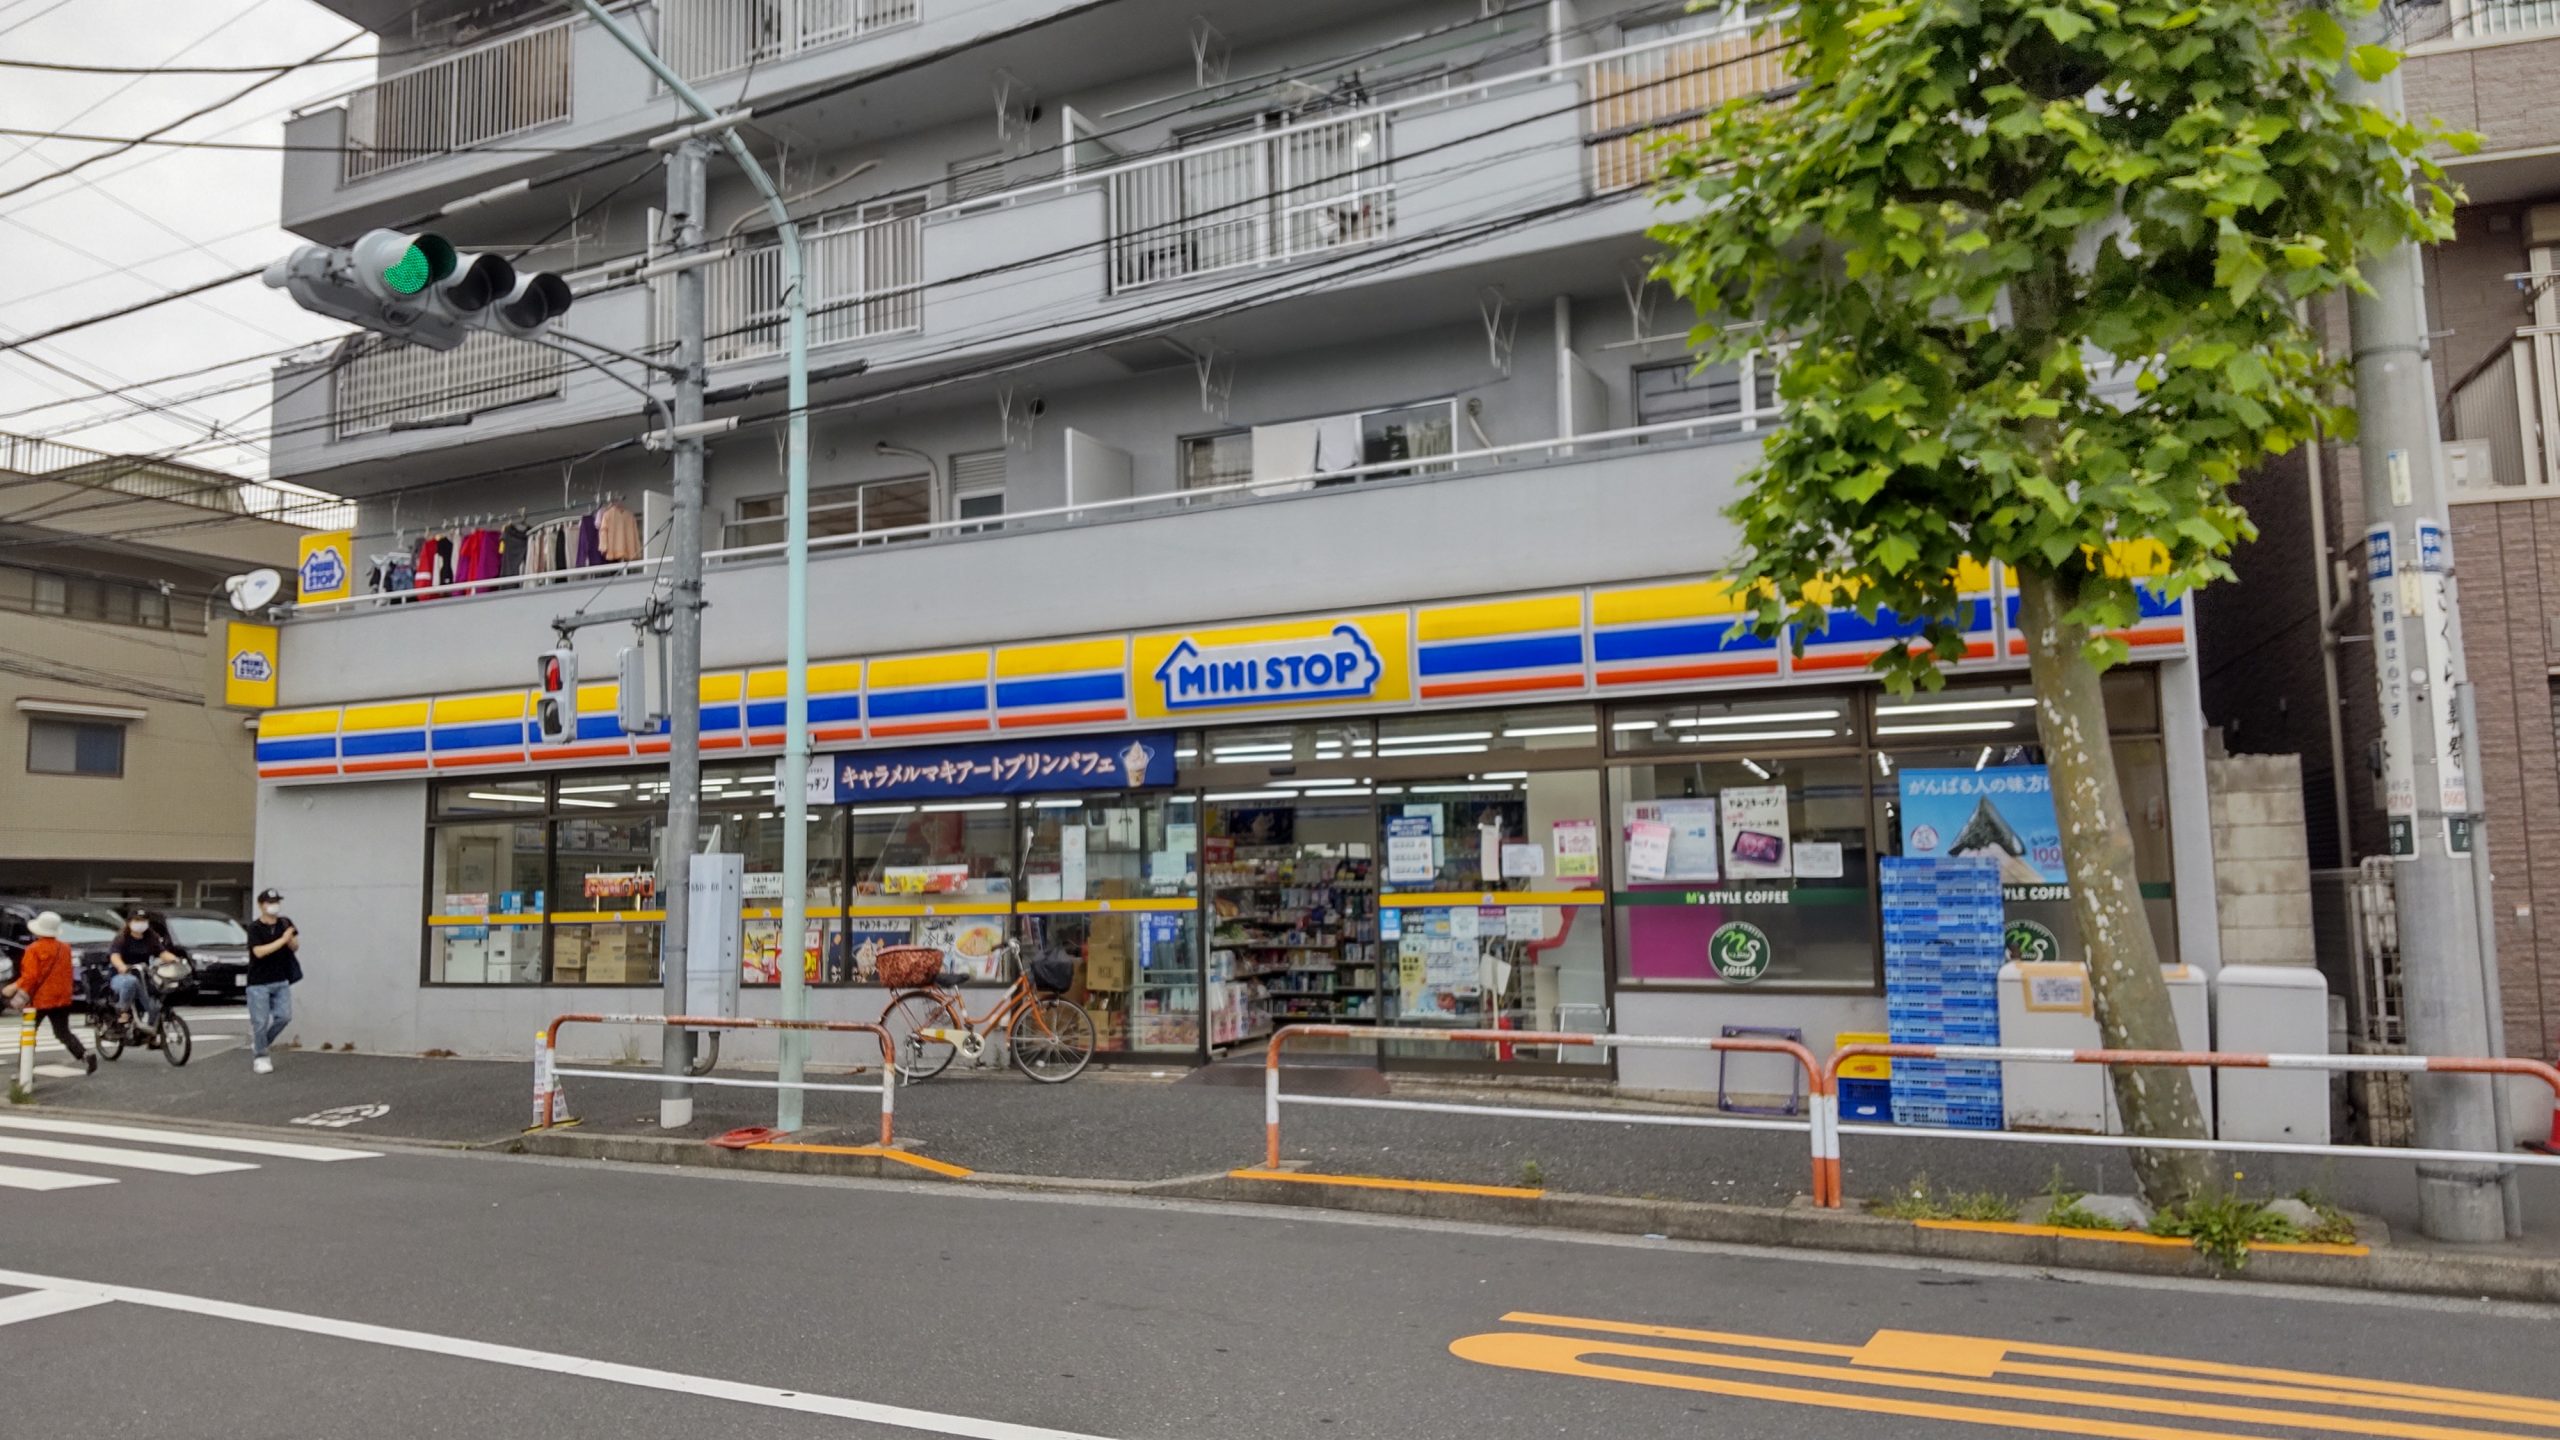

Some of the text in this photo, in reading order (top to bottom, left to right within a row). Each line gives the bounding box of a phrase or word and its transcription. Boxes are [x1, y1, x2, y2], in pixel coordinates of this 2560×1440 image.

[310, 560, 335, 573] MINI
[309, 573, 336, 588] STOP
[241, 658, 264, 668] MINI
[240, 667, 265, 677] STOP
[1179, 652, 1358, 695] MINI STOP
[840, 751, 1117, 790] キャラメルマキアートプリンパフェ
[1686, 890, 1789, 904] M's STYLE COFFEE
[2029, 885, 2072, 901] COFFE
[1722, 965, 1757, 977] COFFEE
